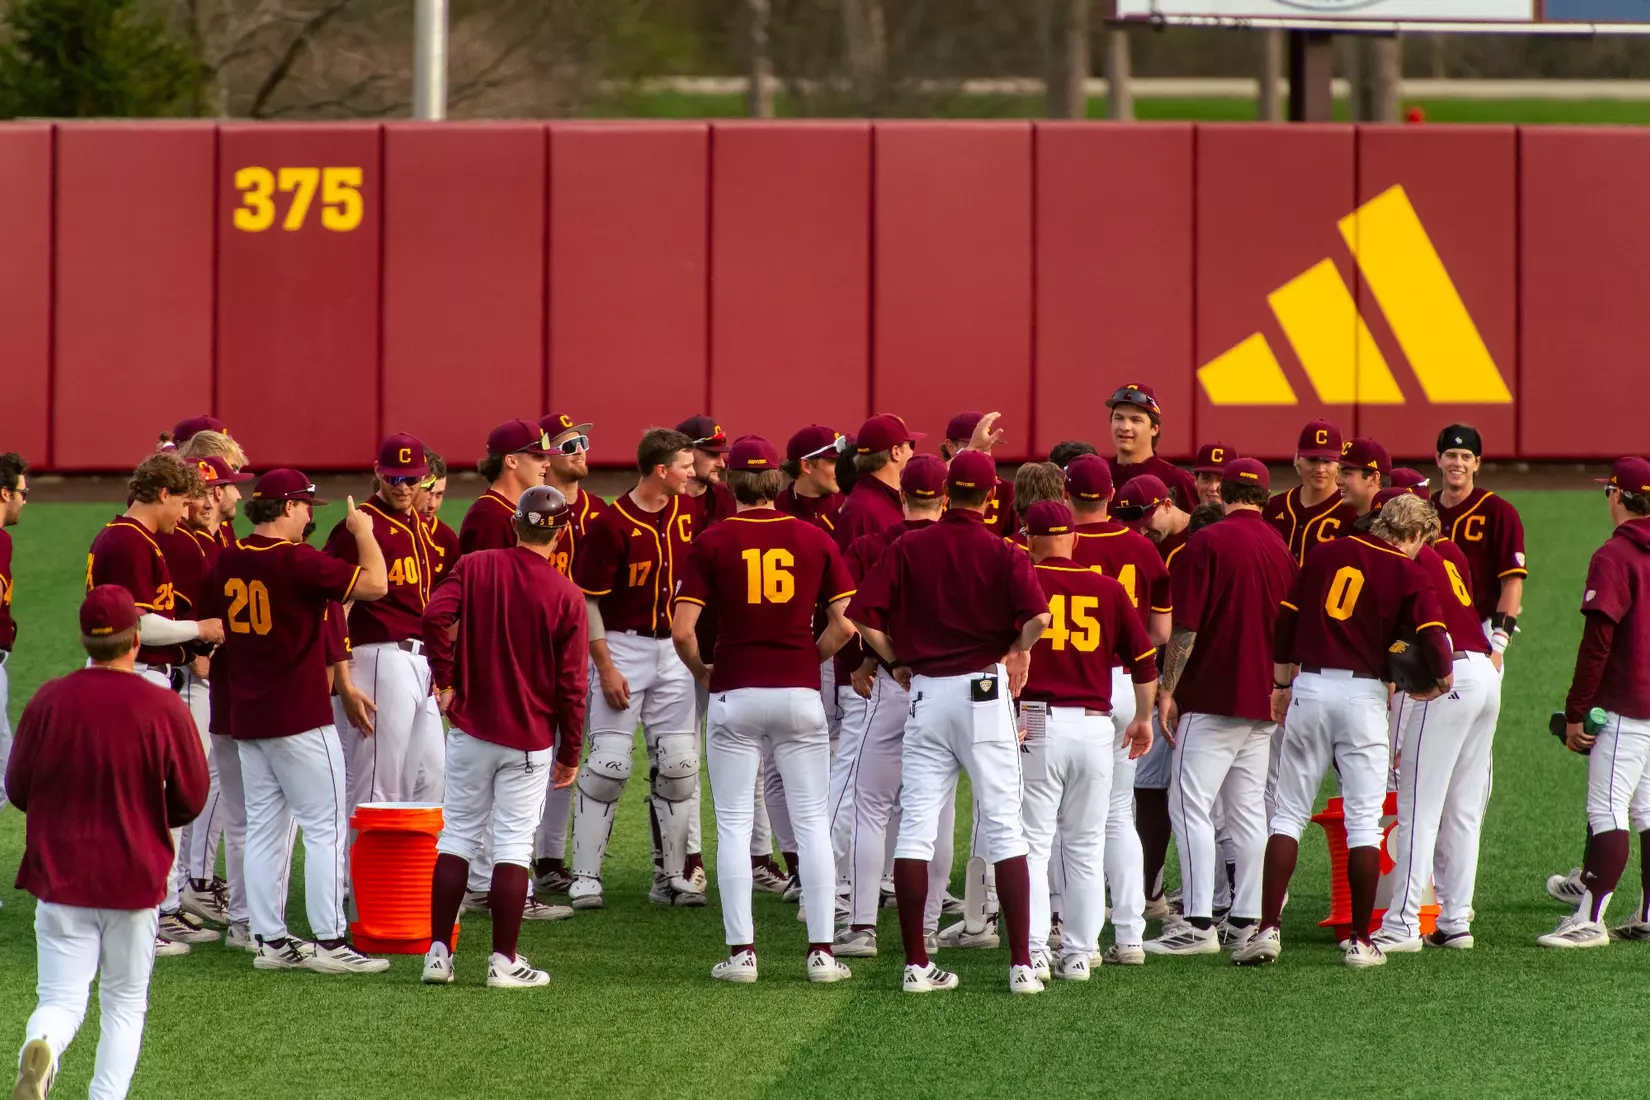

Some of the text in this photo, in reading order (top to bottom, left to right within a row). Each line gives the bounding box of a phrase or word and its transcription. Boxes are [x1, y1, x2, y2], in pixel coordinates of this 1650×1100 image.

[233, 166, 364, 232] 375
[560, 415, 574, 428] C
[1316, 430, 1328, 444] C
[399, 448, 412, 463] C
[1211, 448, 1224, 463] C
[677, 514, 692, 542] C
[1317, 517, 1341, 542] C
[1464, 515, 1486, 541] C
[388, 556, 418, 586] 40
[628, 560, 651, 587] 17
[742, 548, 795, 604] 16
[153, 582, 175, 610] 25
[224, 578, 273, 636] 20
[1325, 566, 1365, 621] 0
[1040, 594, 1101, 652] 45
